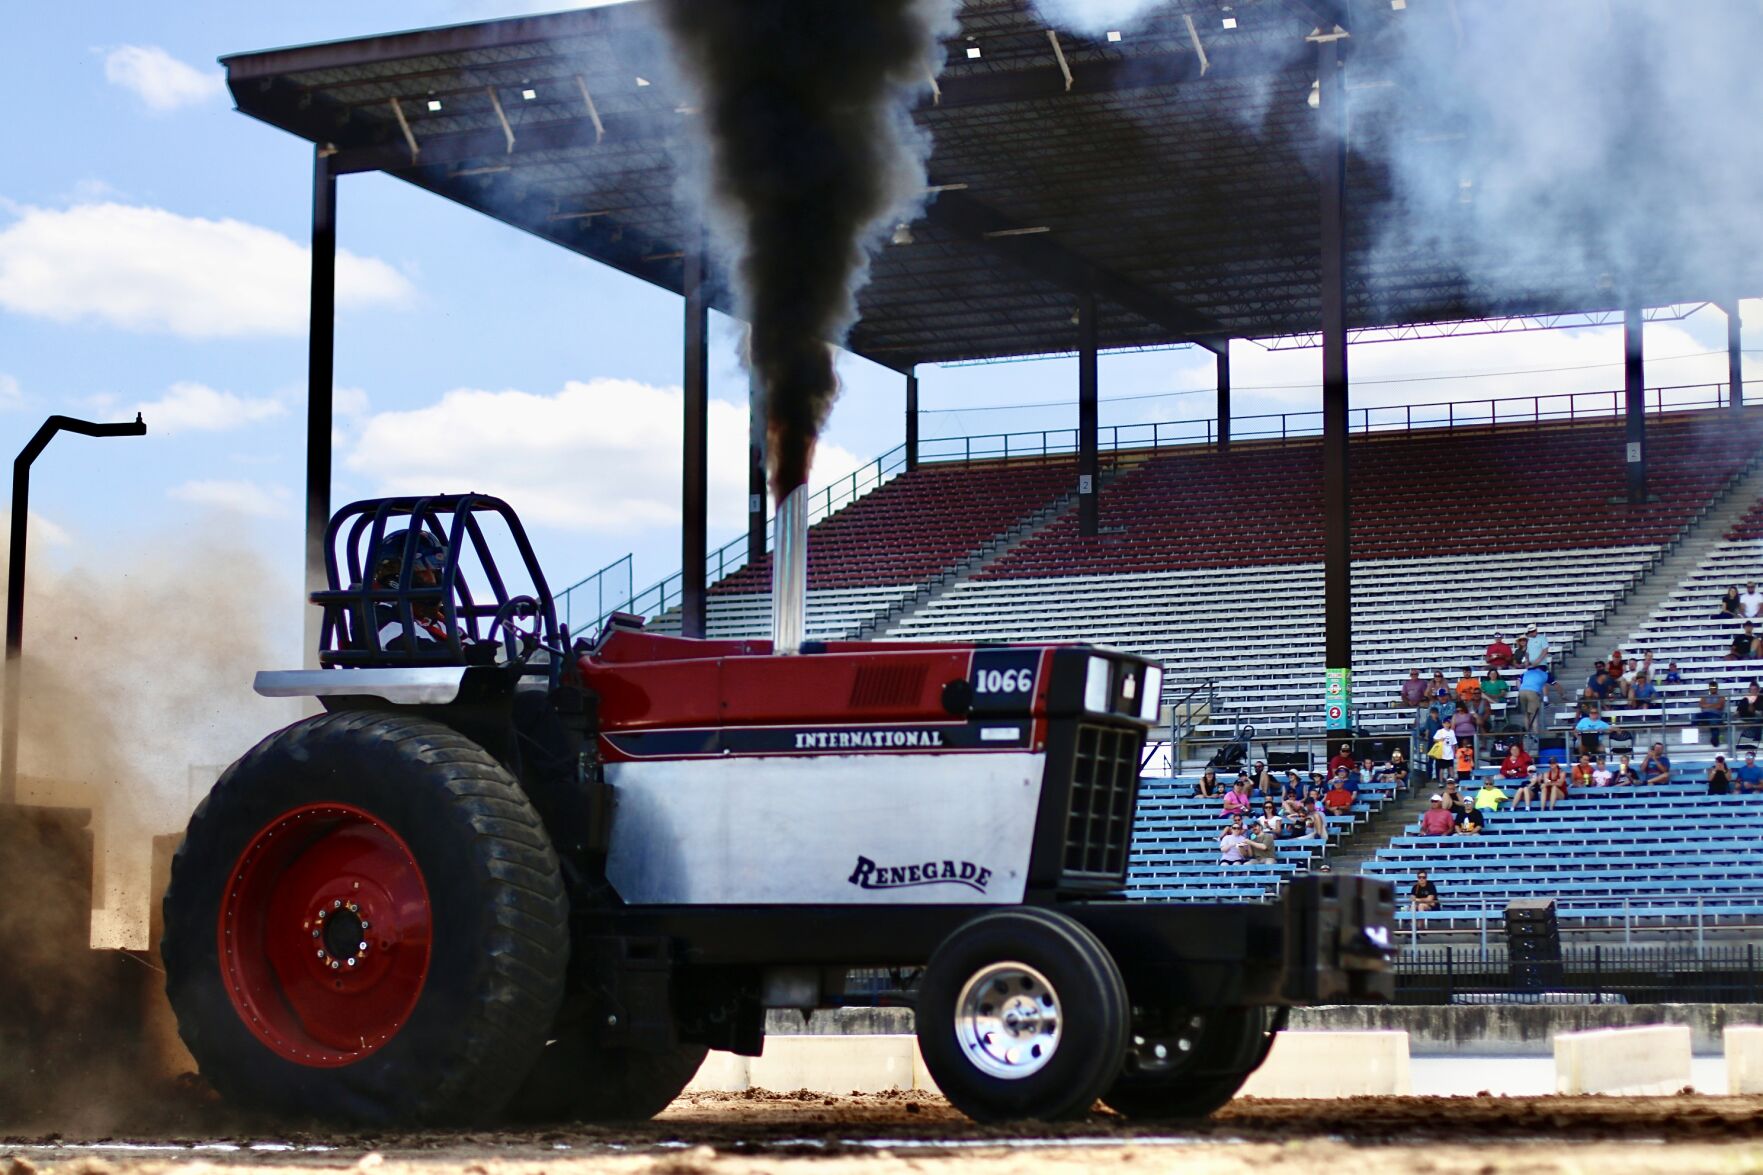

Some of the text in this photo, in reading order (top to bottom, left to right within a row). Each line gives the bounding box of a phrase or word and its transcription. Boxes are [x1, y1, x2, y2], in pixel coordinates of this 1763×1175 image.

[976, 668, 1032, 693] 1066
[1331, 709, 1338, 717] 2
[795, 731, 943, 748] INTERNATIONAL
[848, 855, 992, 890] RENEGADE
